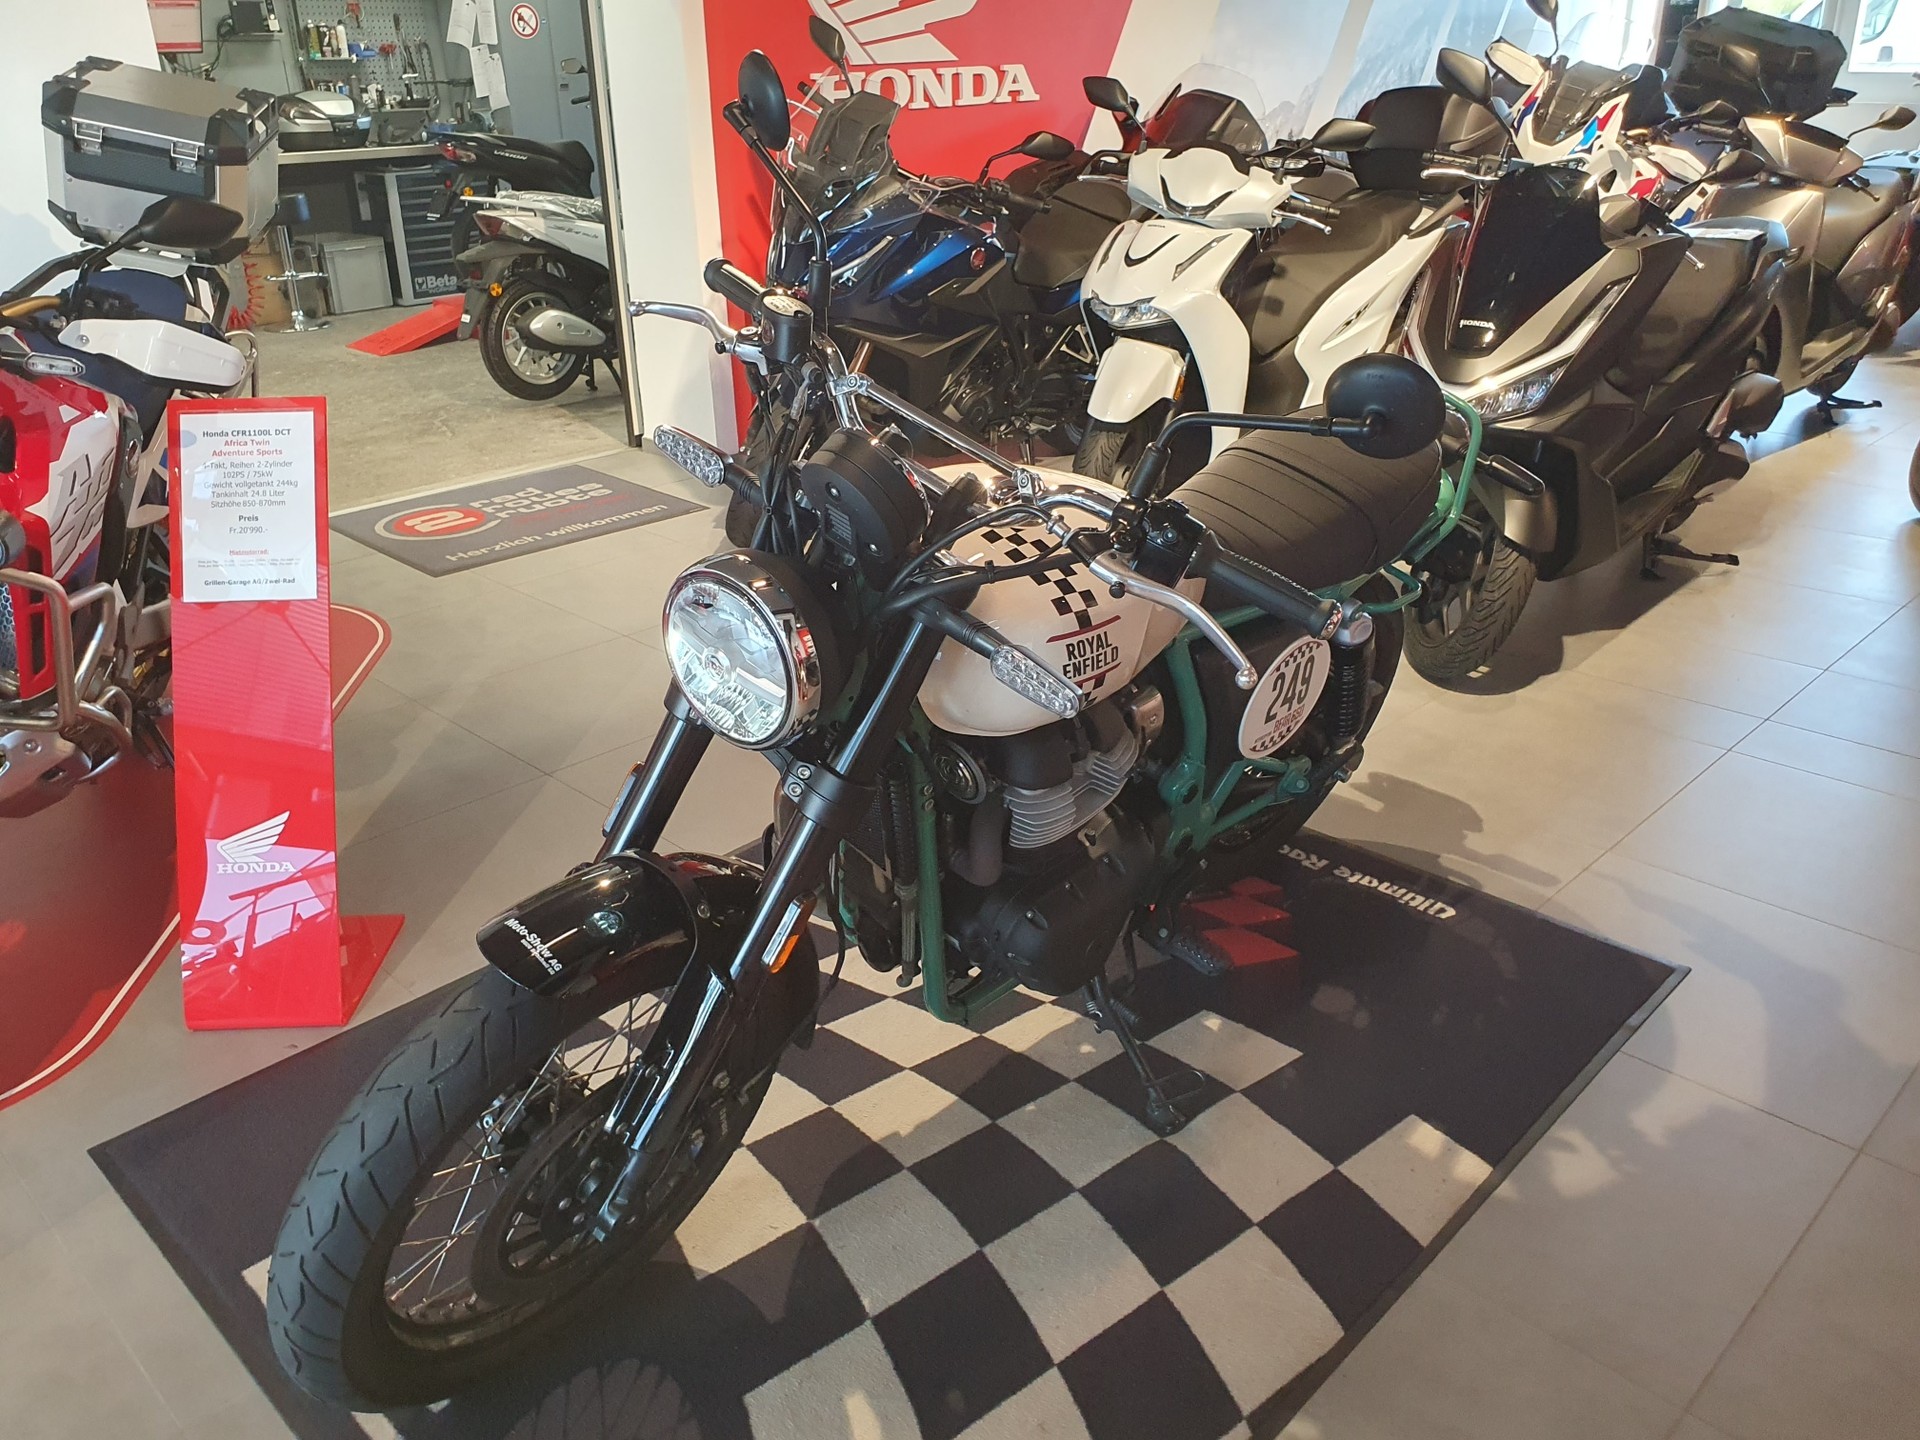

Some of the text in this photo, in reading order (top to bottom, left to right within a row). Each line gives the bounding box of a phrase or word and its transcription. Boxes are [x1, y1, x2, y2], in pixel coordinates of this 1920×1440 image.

[809, 63, 1040, 113] HONDA
[426, 273, 458, 289] Beta
[1459, 318, 1496, 330] HONDA
[202, 428, 291, 438] Honda CFR1100L DCT
[224, 438, 270, 447] Africa Twin
[211, 448, 283, 457] Adventure Sports
[230, 460, 255, 469] Reihen
[257, 460, 293, 469] 2-Zylinder
[223, 471, 245, 479] 102PS
[253, 470, 274, 478] 75kW
[203, 479, 299, 489] Gewicht vollgetankt 244kg
[212, 489, 286, 498] Tankinhalt 24.8 Liter
[469, 486, 544, 509] rad
[481, 482, 604, 513] roues
[211, 499, 286, 509] Sitzhöhe 850-870mm
[499, 487, 613, 519] ruote
[238, 514, 259, 522] Preis
[445, 534, 543, 562] Herzlich
[545, 503, 669, 538] willkommen
[204, 578, 251, 587] Grillen-Garage
[1065, 631, 1113, 662] ROYAL
[1062, 645, 1119, 680] ENFIELD
[1264, 654, 1315, 725] 249
[216, 861, 297, 874] HONDA
[1332, 864, 1457, 920] Ultimate
[503, 917, 554, 959] Moto-Show
[547, 956, 563, 973] AG
